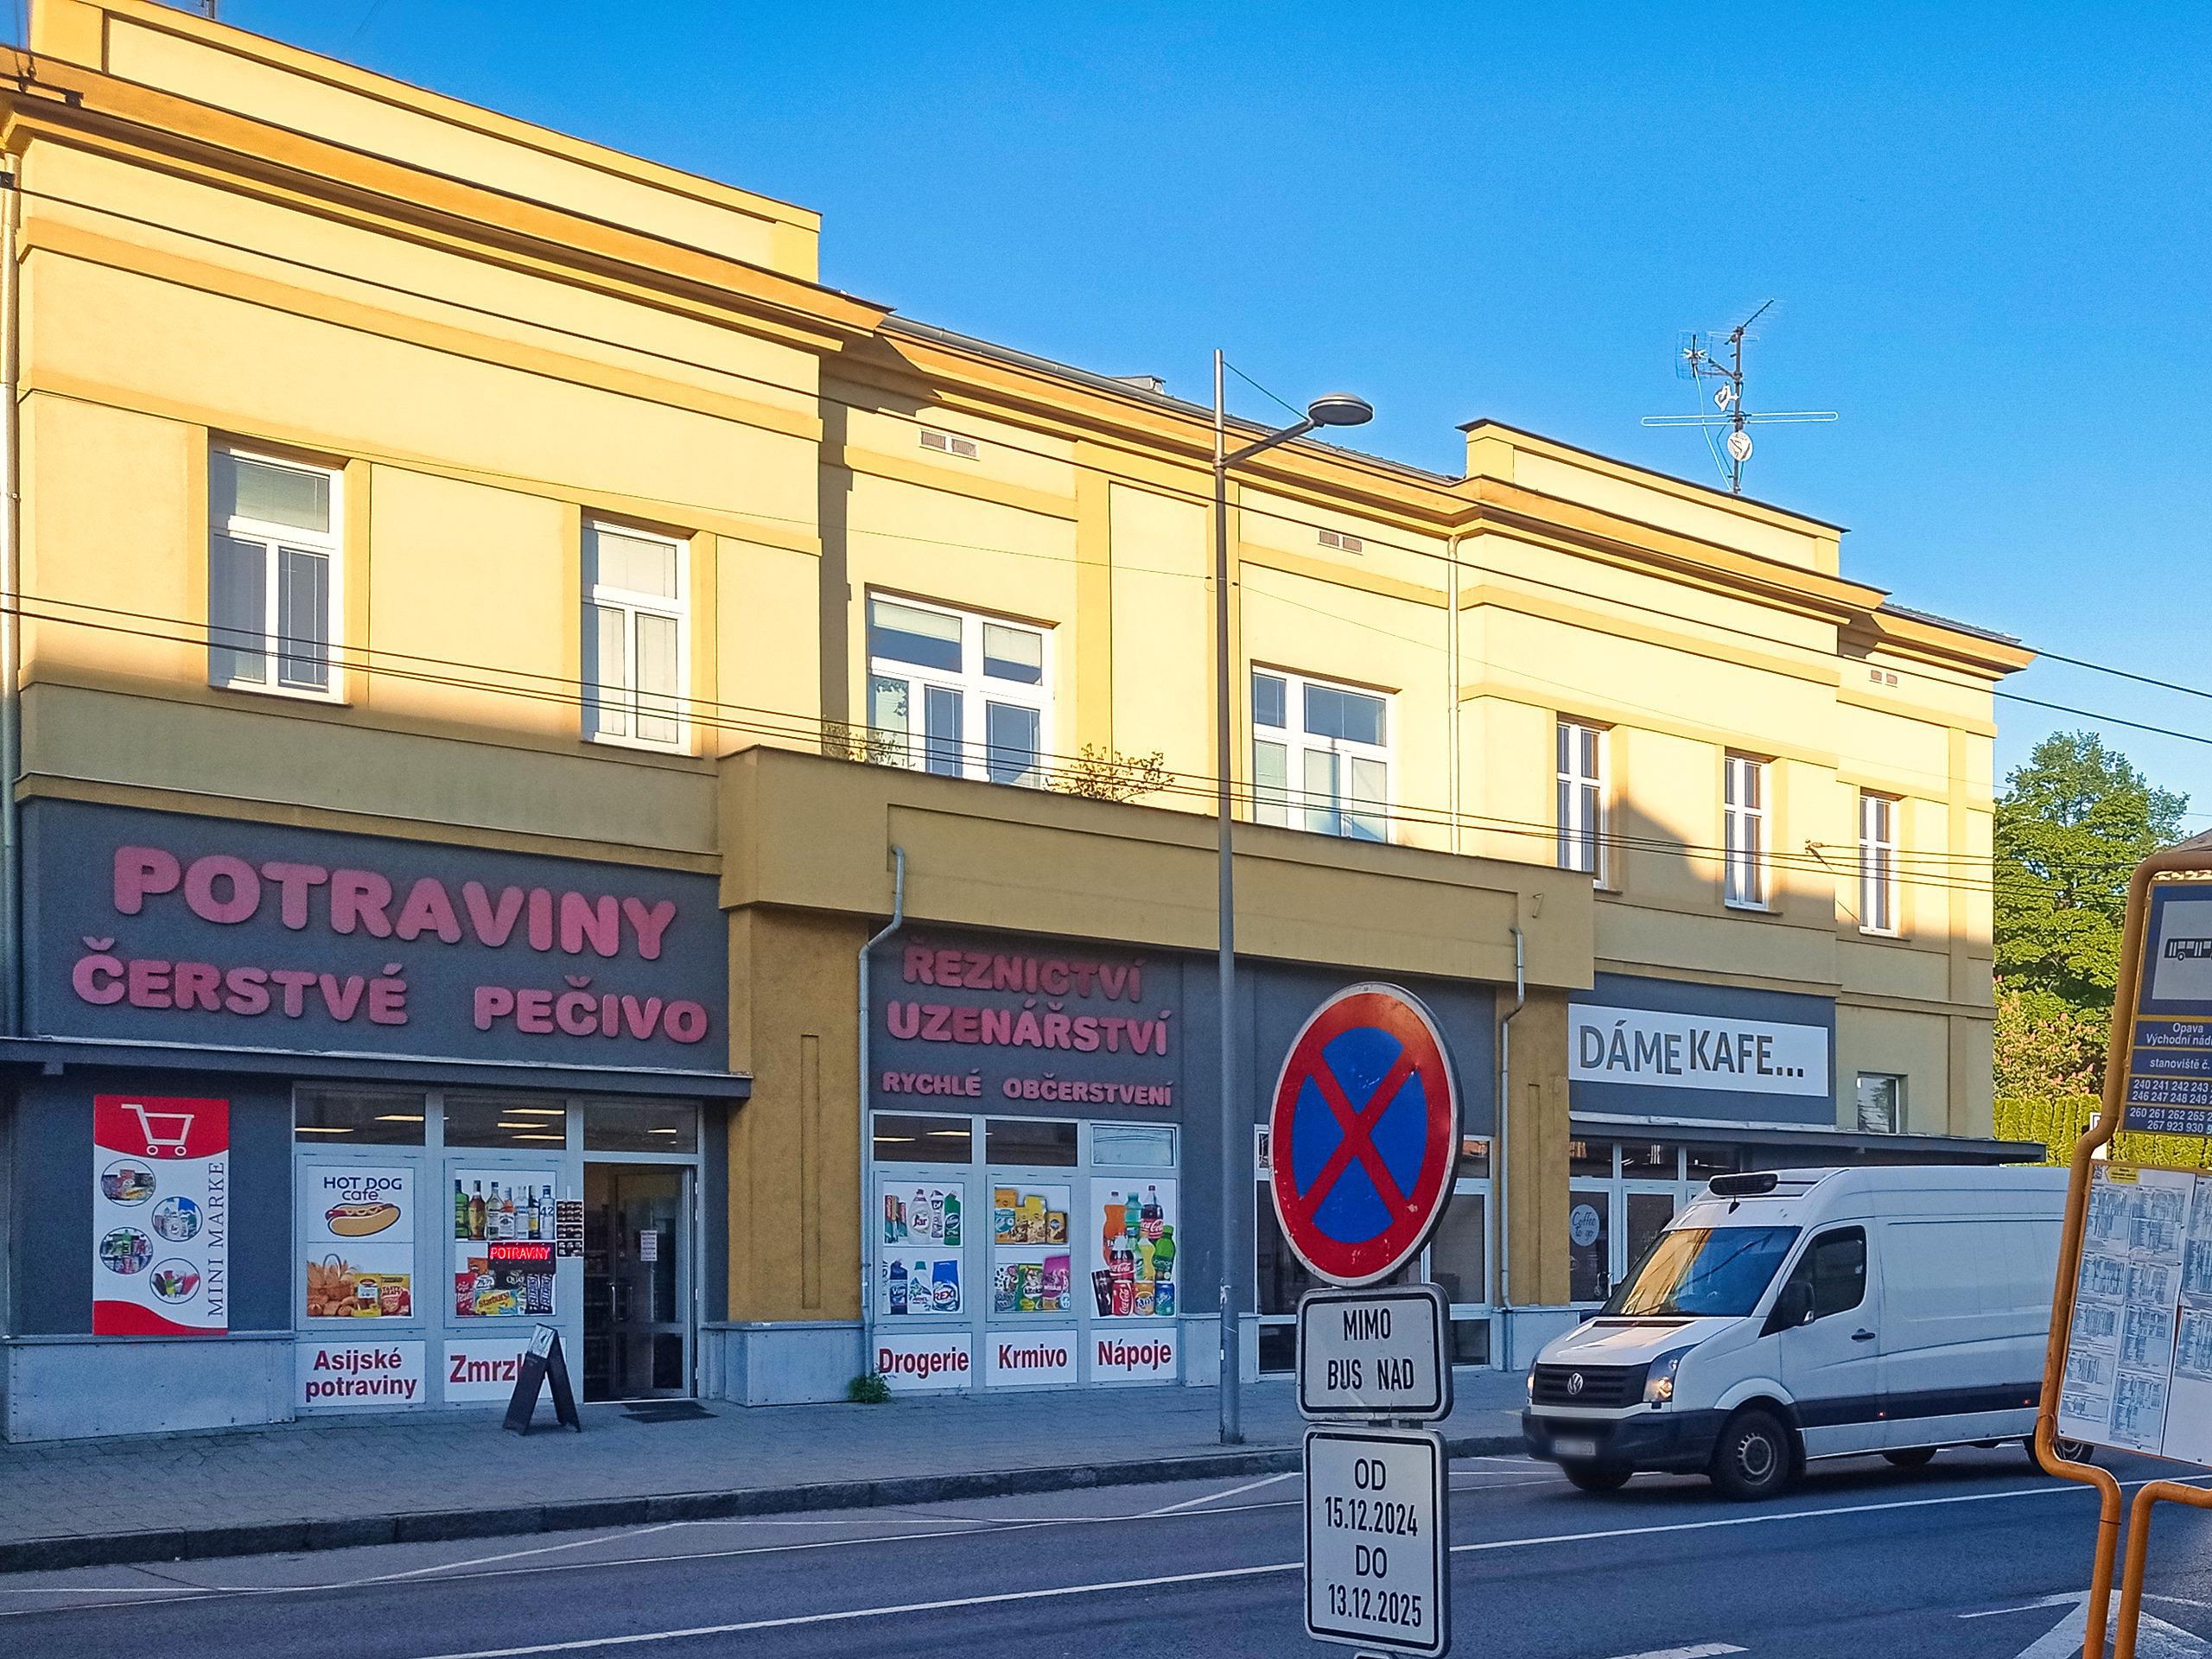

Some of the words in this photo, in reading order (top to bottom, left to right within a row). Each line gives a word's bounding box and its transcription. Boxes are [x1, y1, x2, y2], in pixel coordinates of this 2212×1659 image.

[113, 845, 677, 961] POTRAVINY
[903, 935, 1145, 1002] ŘEZNICTVÍ
[72, 936, 408, 1026] ČERSTVÉ
[474, 975, 709, 1044] PEČIVO
[887, 999, 1171, 1056] UZENÁŘSTVÍ
[2145, 1033, 2191, 1046] Východní
[2192, 1035, 2212, 1046] nád
[2172, 1022, 2203, 1035] Opava
[1580, 1020, 1682, 1075] DÁME
[2150, 1058, 2200, 1070] stanoviště
[2202, 1060, 2210, 1070] č.
[882, 1068, 982, 1096] RYCHLÉ
[1002, 1072, 1174, 1107] OBČERSTVENÍ
[2132, 1090, 2149, 1101] 246
[2151, 1091, 2168, 1103] 247
[2170, 1093, 2187, 1103] 248
[2190, 1094, 2207, 1104] 249
[2133, 1079, 2151, 1090] 240
[2152, 1080, 2169, 1090] 241
[2171, 1081, 2189, 1092] 242
[2190, 1082, 2209, 1093] 243
[2130, 1107, 2146, 1118] 260
[2149, 1109, 2165, 1119] 261
[2168, 1109, 2185, 1121] 262
[2187, 1110, 2204, 1122] 265
[2147, 1120, 2164, 1130] 267
[2166, 1121, 2183, 1132] 923
[2186, 1122, 2203, 1133] 930
[323, 1177, 361, 1189] HOT
[366, 1178, 402, 1190] DOG
[208, 1162, 225, 1249] MARKE
[540, 1205, 555, 1216] 42
[208, 1260, 224, 1317] MINI
[1343, 1308, 1391, 1341] MIMO
[313, 1347, 402, 1374] Asijské
[449, 1353, 524, 1383] Zmrzl
[879, 1345, 969, 1380] Drogerie
[998, 1343, 1068, 1370] Krmivo
[1097, 1338, 1172, 1372] Nápoje
[305, 1375, 417, 1402] potraviny
[1327, 1359, 1363, 1390] BUS
[1376, 1357, 1414, 1390] NAD
[1354, 1458, 1387, 1491] OD
[1325, 1496, 1418, 1537] 15.12.2024
[1355, 1544, 1388, 1579] DO
[1328, 1583, 1421, 1628] 13.12.2025
